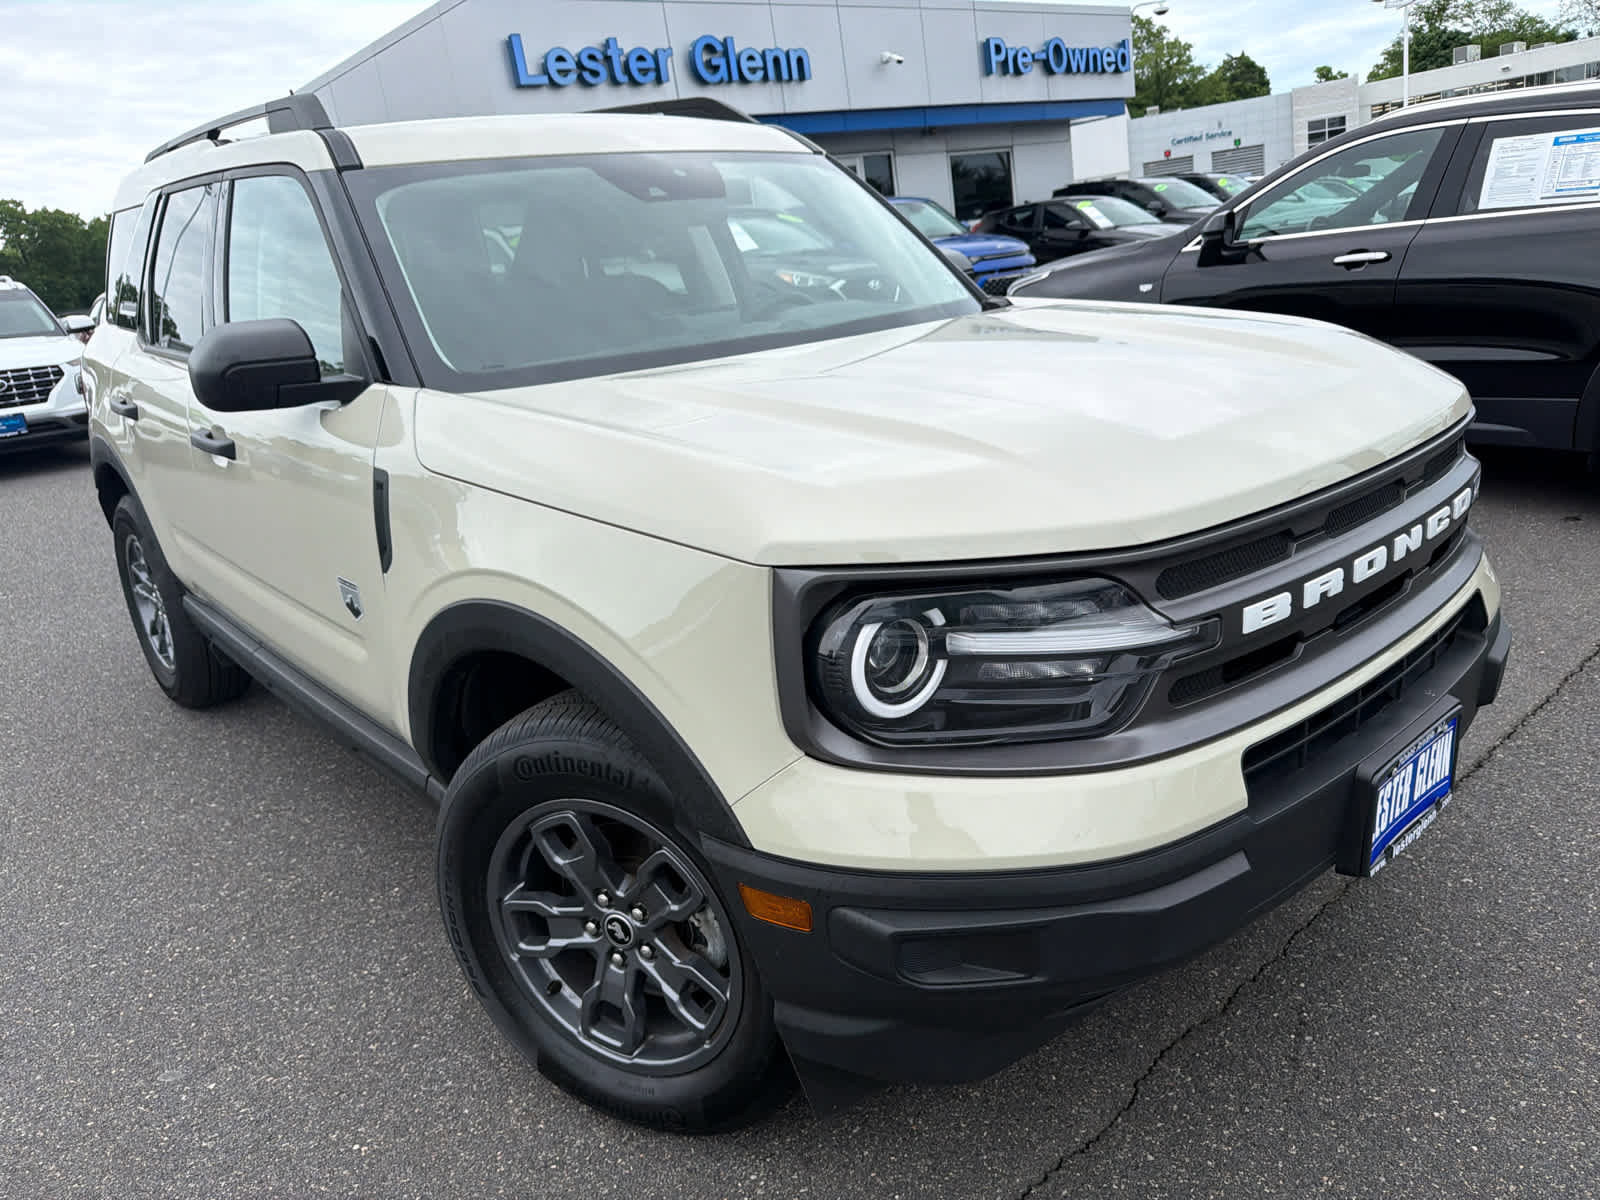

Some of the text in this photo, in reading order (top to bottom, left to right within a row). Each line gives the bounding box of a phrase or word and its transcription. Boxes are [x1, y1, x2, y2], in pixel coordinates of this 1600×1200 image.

[508, 33, 812, 88] Lester Glenn
[984, 36, 1131, 76] Pre-Owned
[1171, 130, 1232, 145] Certified Service
[1242, 487, 1472, 635] BRONCO
[1371, 763, 1414, 845] ESTER
[1413, 729, 1454, 802] GLENN
